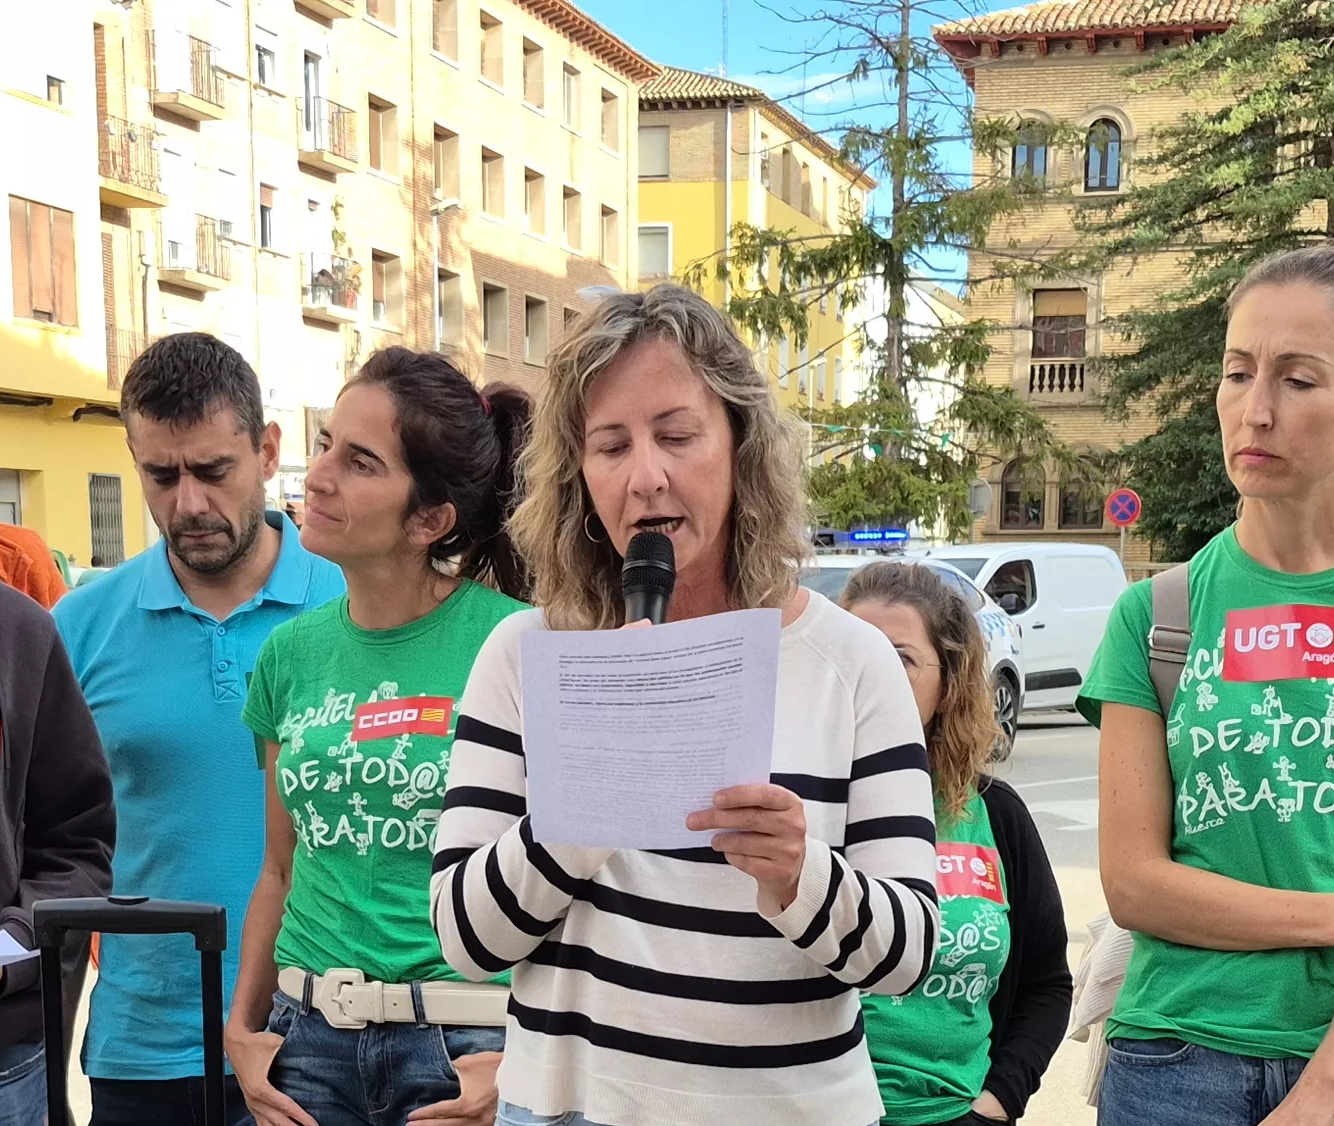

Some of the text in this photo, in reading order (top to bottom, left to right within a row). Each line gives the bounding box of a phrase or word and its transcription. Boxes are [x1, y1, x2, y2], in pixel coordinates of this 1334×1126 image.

[1234, 623, 1302, 652] UGT
[358, 708, 419, 729] CCOO
[1189, 718, 1243, 758] DE
[280, 759, 320, 797] DE
[1178, 778, 1277, 824] PARA
[361, 814, 438, 855] TOD
[935, 854, 966, 874] GT
